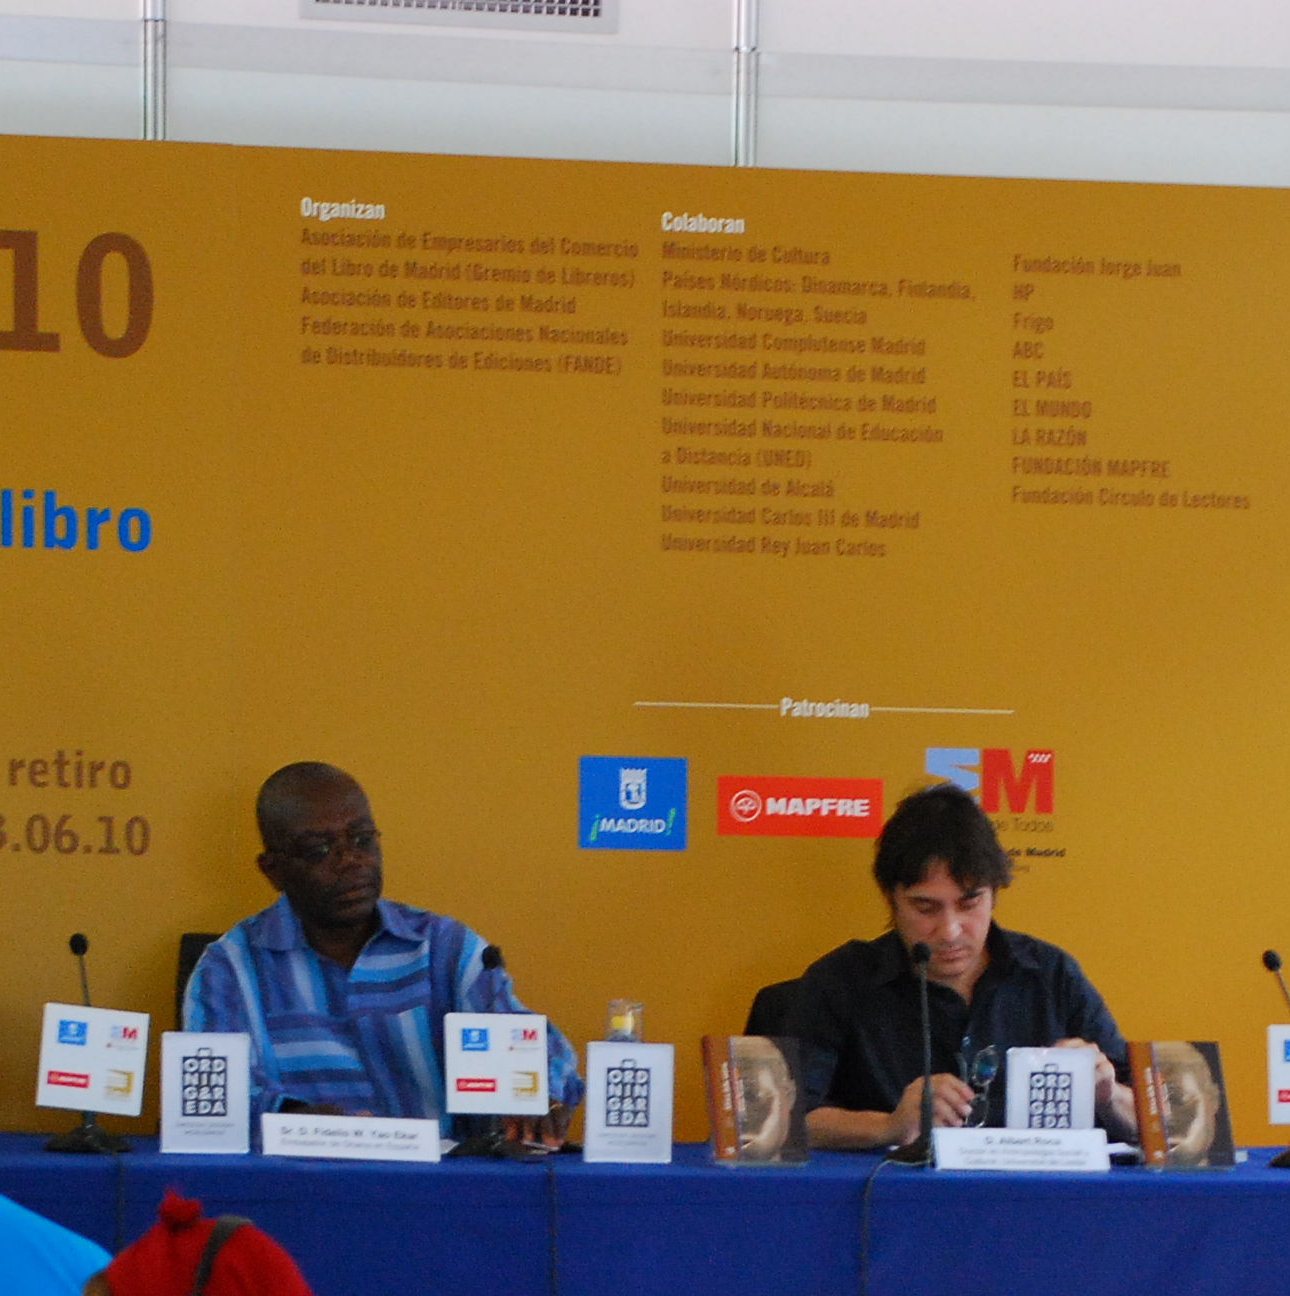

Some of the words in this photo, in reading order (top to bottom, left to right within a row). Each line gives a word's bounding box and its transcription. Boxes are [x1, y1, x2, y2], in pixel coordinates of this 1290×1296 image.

[301, 197, 385, 221] Organizan
[661, 211, 745, 234] Colaboran
[301, 228, 391, 248] Asociación
[398, 231, 416, 248] de
[422, 232, 525, 255] Empresarios
[530, 236, 555, 254] del
[561, 238, 639, 257] Comercio
[662, 241, 742, 262] Ministerio
[748, 244, 767, 262] de
[772, 246, 831, 265] Cultura
[301, 257, 326, 275] del
[331, 259, 374, 278] Libro
[379, 261, 398, 279] de
[405, 261, 460, 280] Madrid
[536, 265, 556, 284] de
[1013, 254, 1095, 274] Fundación
[1099, 257, 1142, 280] Jorge
[1146, 259, 1182, 277] Juan
[301, 287, 391, 307] Asociación
[397, 290, 416, 308] de
[422, 291, 490, 311] Editores
[495, 294, 515, 311] de
[520, 295, 576, 314] Madrid
[1013, 283, 1034, 301] HP
[813, 305, 867, 324] Suecia
[1013, 312, 1054, 334] Frigo
[301, 316, 395, 337] Federación
[400, 320, 420, 338] de
[426, 321, 534, 342] Asociaciones
[539, 324, 628, 345] Nacionales
[662, 329, 757, 350] Universidad
[762, 333, 866, 354] Complutense
[871, 336, 926, 356] Madrid
[1013, 341, 1044, 360] ABC
[301, 346, 321, 365] de
[326, 347, 443, 368] Distribuidores
[448, 351, 468, 369] de
[473, 351, 552, 372] Ediciones
[559, 353, 622, 375] (FANDE)
[662, 359, 757, 380] Universidad
[762, 361, 841, 382] Autónoma
[846, 364, 866, 383] de
[871, 366, 926, 385] Madrid
[1013, 370, 1029, 388] EL
[662, 388, 757, 408] Universidad
[857, 393, 877, 412] de
[881, 394, 937, 414] Madrid
[1013, 399, 1029, 417] EL
[1036, 399, 1092, 419] MUNDO
[662, 417, 757, 438] Universidad
[762, 419, 832, 440] Nacional
[836, 423, 856, 441] de
[861, 422, 944, 443] Educación
[1013, 428, 1031, 445] LA
[677, 446, 751, 465] Distancia
[1012, 455, 1102, 476] FUNDACIÓN
[1107, 459, 1170, 478] MAPFRE
[662, 475, 756, 495] Universidad
[761, 479, 781, 496] de
[1012, 485, 1093, 505] Fundación
[1160, 490, 1178, 507] de
[1183, 491, 1250, 510] Lectores
[0, 488, 153, 553] libro
[662, 504, 756, 524] Universidad
[762, 506, 811, 526] Carlos
[817, 508, 835, 526] III
[841, 509, 859, 527] de
[865, 510, 920, 530] Madrid
[662, 533, 756, 554] Universidad
[760, 536, 790, 558] Rey
[795, 538, 830, 556] Juan
[835, 538, 887, 558] Carlos
[779, 697, 870, 719] Patrocinan
[10, 749, 132, 791] retiro
[766, 797, 870, 817] MAPFRE
[182, 1058, 227, 1073] ORD
[607, 1069, 650, 1084] ORD
[1030, 1074, 1071, 1088] ORD
[182, 1101, 227, 1115] EDA
[607, 1112, 650, 1126] EDA
[1030, 1115, 1071, 1129] EDA
